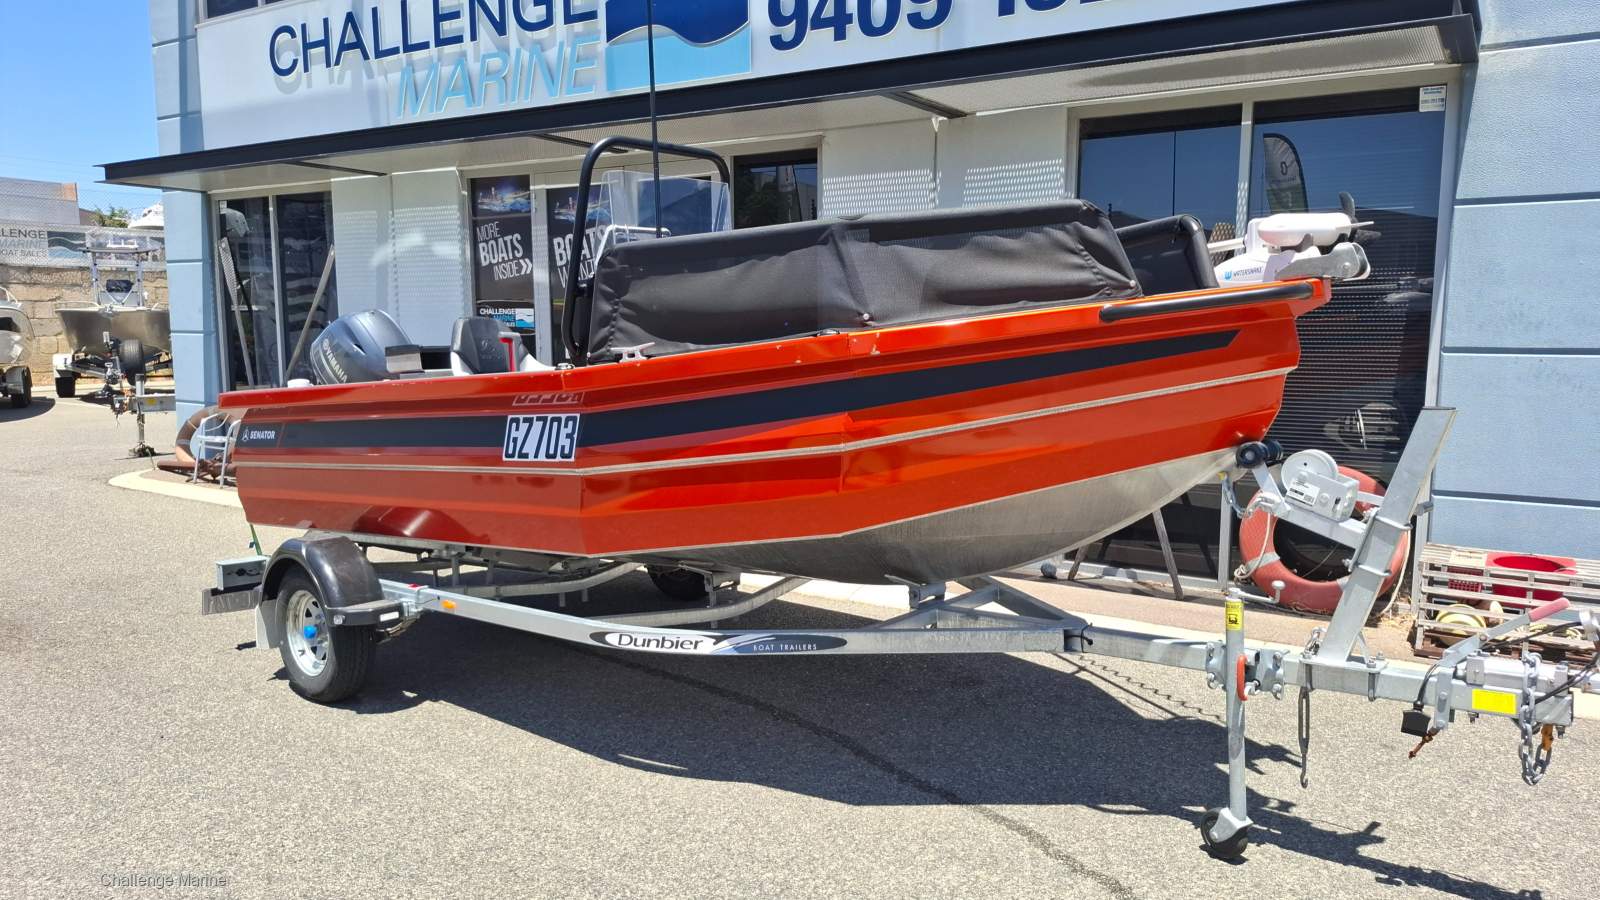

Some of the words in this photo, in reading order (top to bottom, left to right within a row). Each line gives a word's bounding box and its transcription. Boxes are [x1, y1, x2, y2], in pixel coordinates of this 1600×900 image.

[398, 35, 601, 117] MARINE
[0, 228, 47, 239] LENGE
[477, 221, 501, 241] MORE
[479, 233, 524, 267] BOATS
[493, 260, 520, 281] INSIDE
[326, 346, 348, 384] YAMAHA
[250, 430, 276, 440] SENATOR
[504, 415, 578, 459] GZ703
[618, 633, 703, 650] Dunbier
[780, 643, 817, 651] TRAILERS
